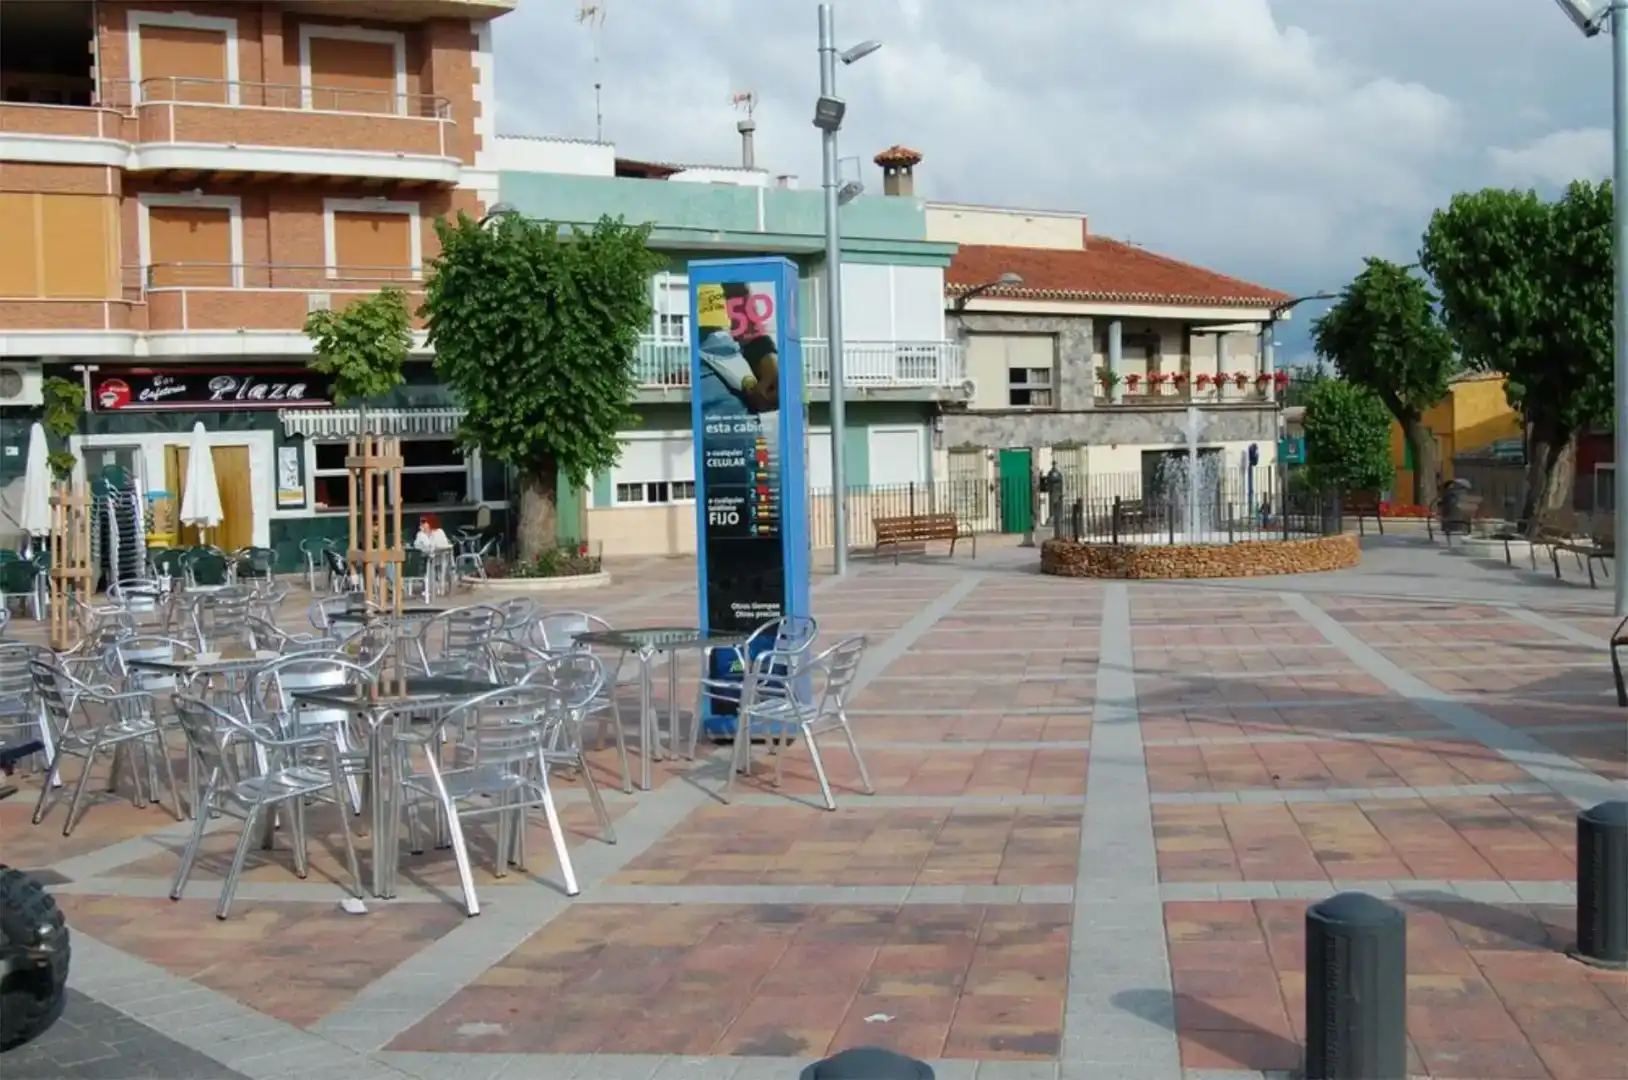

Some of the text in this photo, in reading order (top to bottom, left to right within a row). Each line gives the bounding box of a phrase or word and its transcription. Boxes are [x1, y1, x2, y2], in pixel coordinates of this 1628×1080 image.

[153, 375, 174, 387] Bar
[208, 374, 308, 401] Plaza
[706, 422, 732, 434] esta
[706, 458, 746, 468] CELULAR
[709, 512, 740, 525] FIJO
